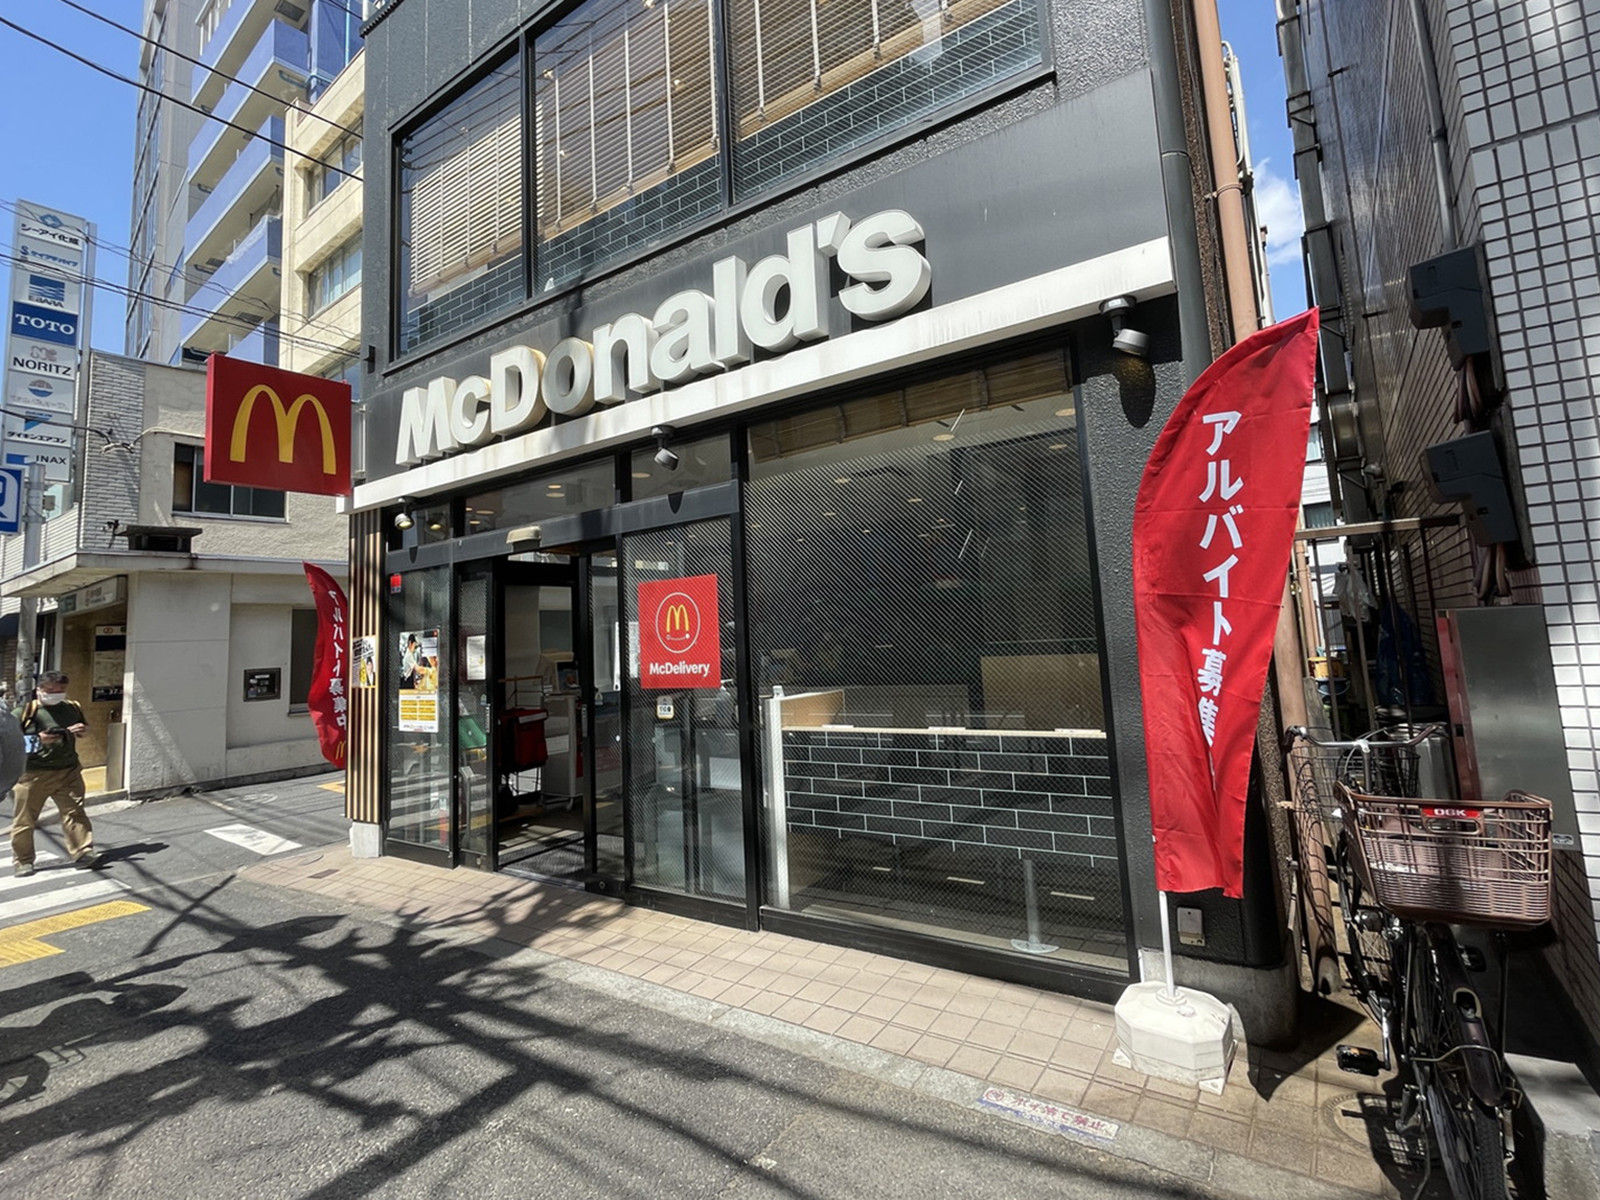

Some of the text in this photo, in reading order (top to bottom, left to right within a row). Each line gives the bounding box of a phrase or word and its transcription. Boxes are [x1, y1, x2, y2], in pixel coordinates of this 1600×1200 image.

[15, 314, 75, 335] TOTO
[396, 209, 933, 466] McDonald's
[13, 356, 72, 377] NORITZ
[36, 454, 67, 465] INAX
[1198, 410, 1244, 790] アルバイト募集
[649, 660, 711, 678] McDelivery
[1433, 808, 1467, 817] OGK
